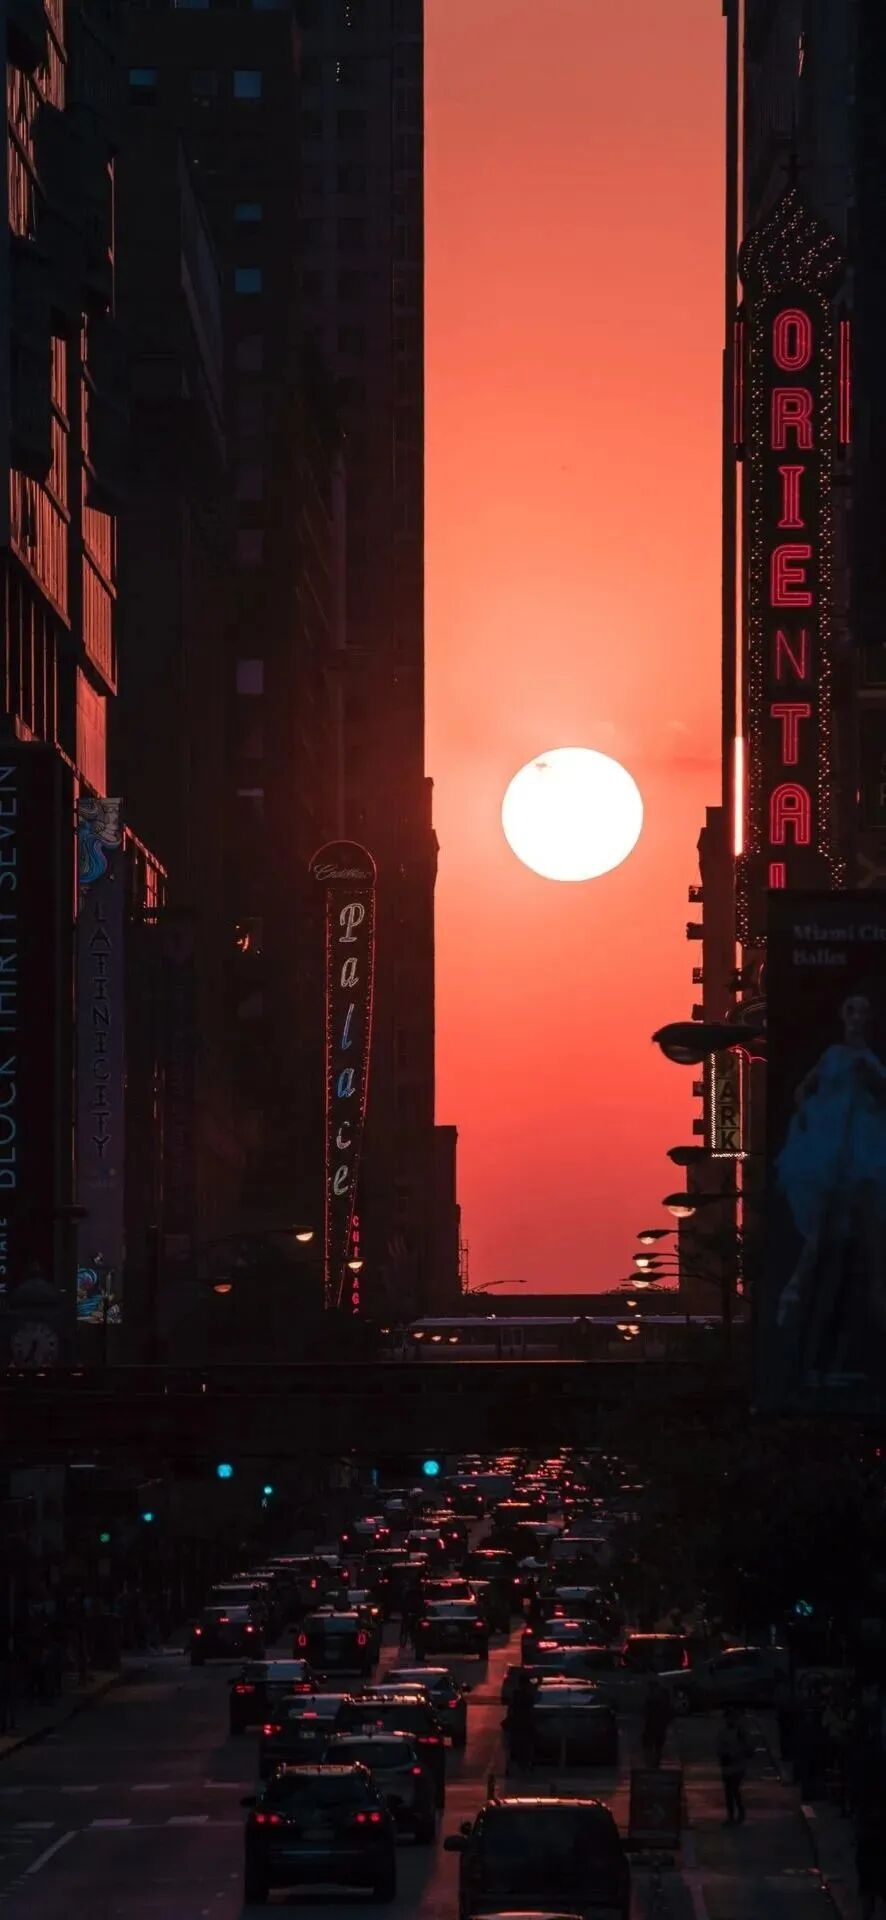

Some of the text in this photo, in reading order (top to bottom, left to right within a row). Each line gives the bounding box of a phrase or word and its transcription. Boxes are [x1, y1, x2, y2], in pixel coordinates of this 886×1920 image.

[89, 901, 112, 1158] LATINICITY
[332, 902, 366, 1197] Palace
[351, 1215, 361, 1316] CHIAG
